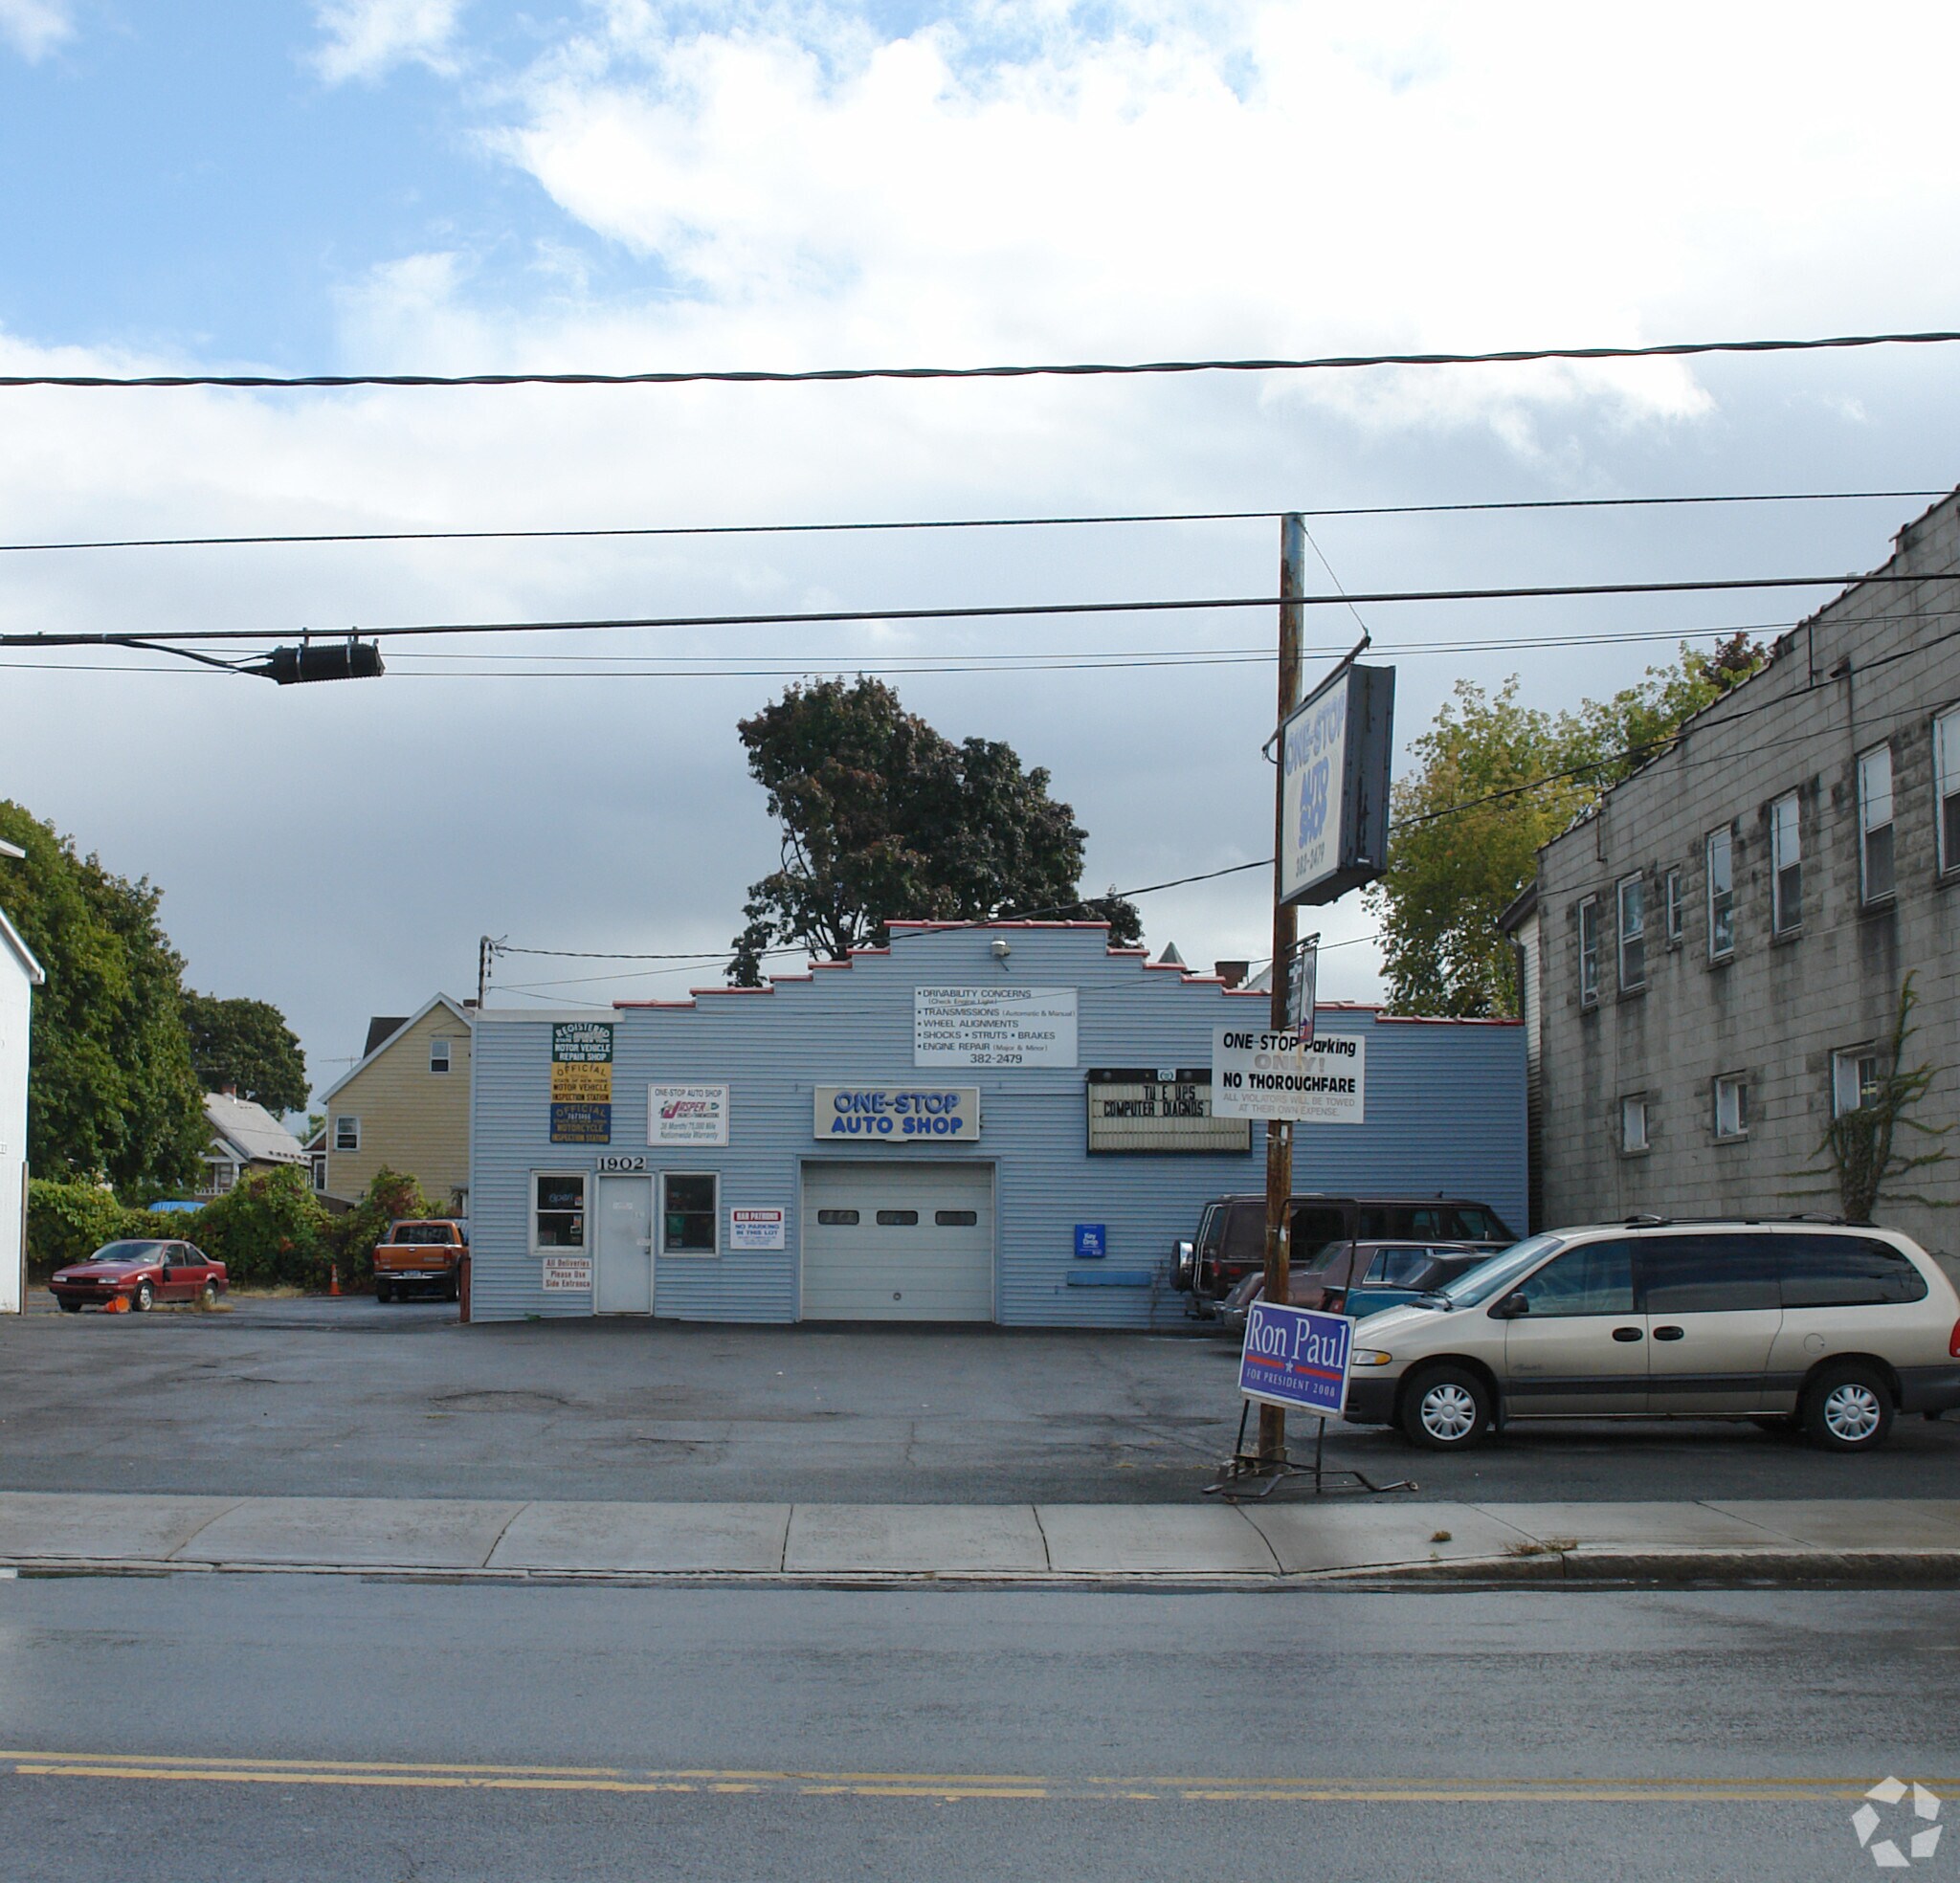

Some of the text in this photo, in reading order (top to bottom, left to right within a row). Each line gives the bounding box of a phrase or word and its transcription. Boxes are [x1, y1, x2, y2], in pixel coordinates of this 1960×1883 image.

[981, 989, 1031, 998] CONCERNS
[924, 1008, 999, 1016] TRANSMISSIONS
[555, 1023, 611, 1038] REGISTERED
[1018, 1031, 1056, 1040] BRAKES
[581, 1044, 611, 1052] VEHICLE
[970, 1053, 1023, 1064] 382-2479
[1255, 1054, 1325, 1073] ONLY!
[556, 1064, 607, 1076] OFFICIAL
[1223, 1073, 1355, 1093] NO THOROUGHFARE
[1175, 1085, 1195, 1100] UPS
[834, 1091, 960, 1114] ONE-STOP
[1241, 1094, 1287, 1104] VIOLATORS
[1326, 1097, 1355, 1107] TOWED
[1103, 1101, 1154, 1117] COMPUTER
[1252, 1104, 1275, 1114] THEIR
[1278, 1105, 1299, 1114] OWN
[831, 1116, 963, 1134] AUTO SHOP
[599, 1157, 645, 1170] 1902
[557, 1258, 590, 1267] Deliveries
[550, 1270, 586, 1278] Please Use
[546, 1279, 590, 1288] Side Entrance
[1248, 1310, 1347, 1368] Ron Paul
[1247, 1367, 1261, 1380] FOR
[1263, 1372, 1309, 1391] PRESIDENT
[1313, 1383, 1335, 1397] 2008
